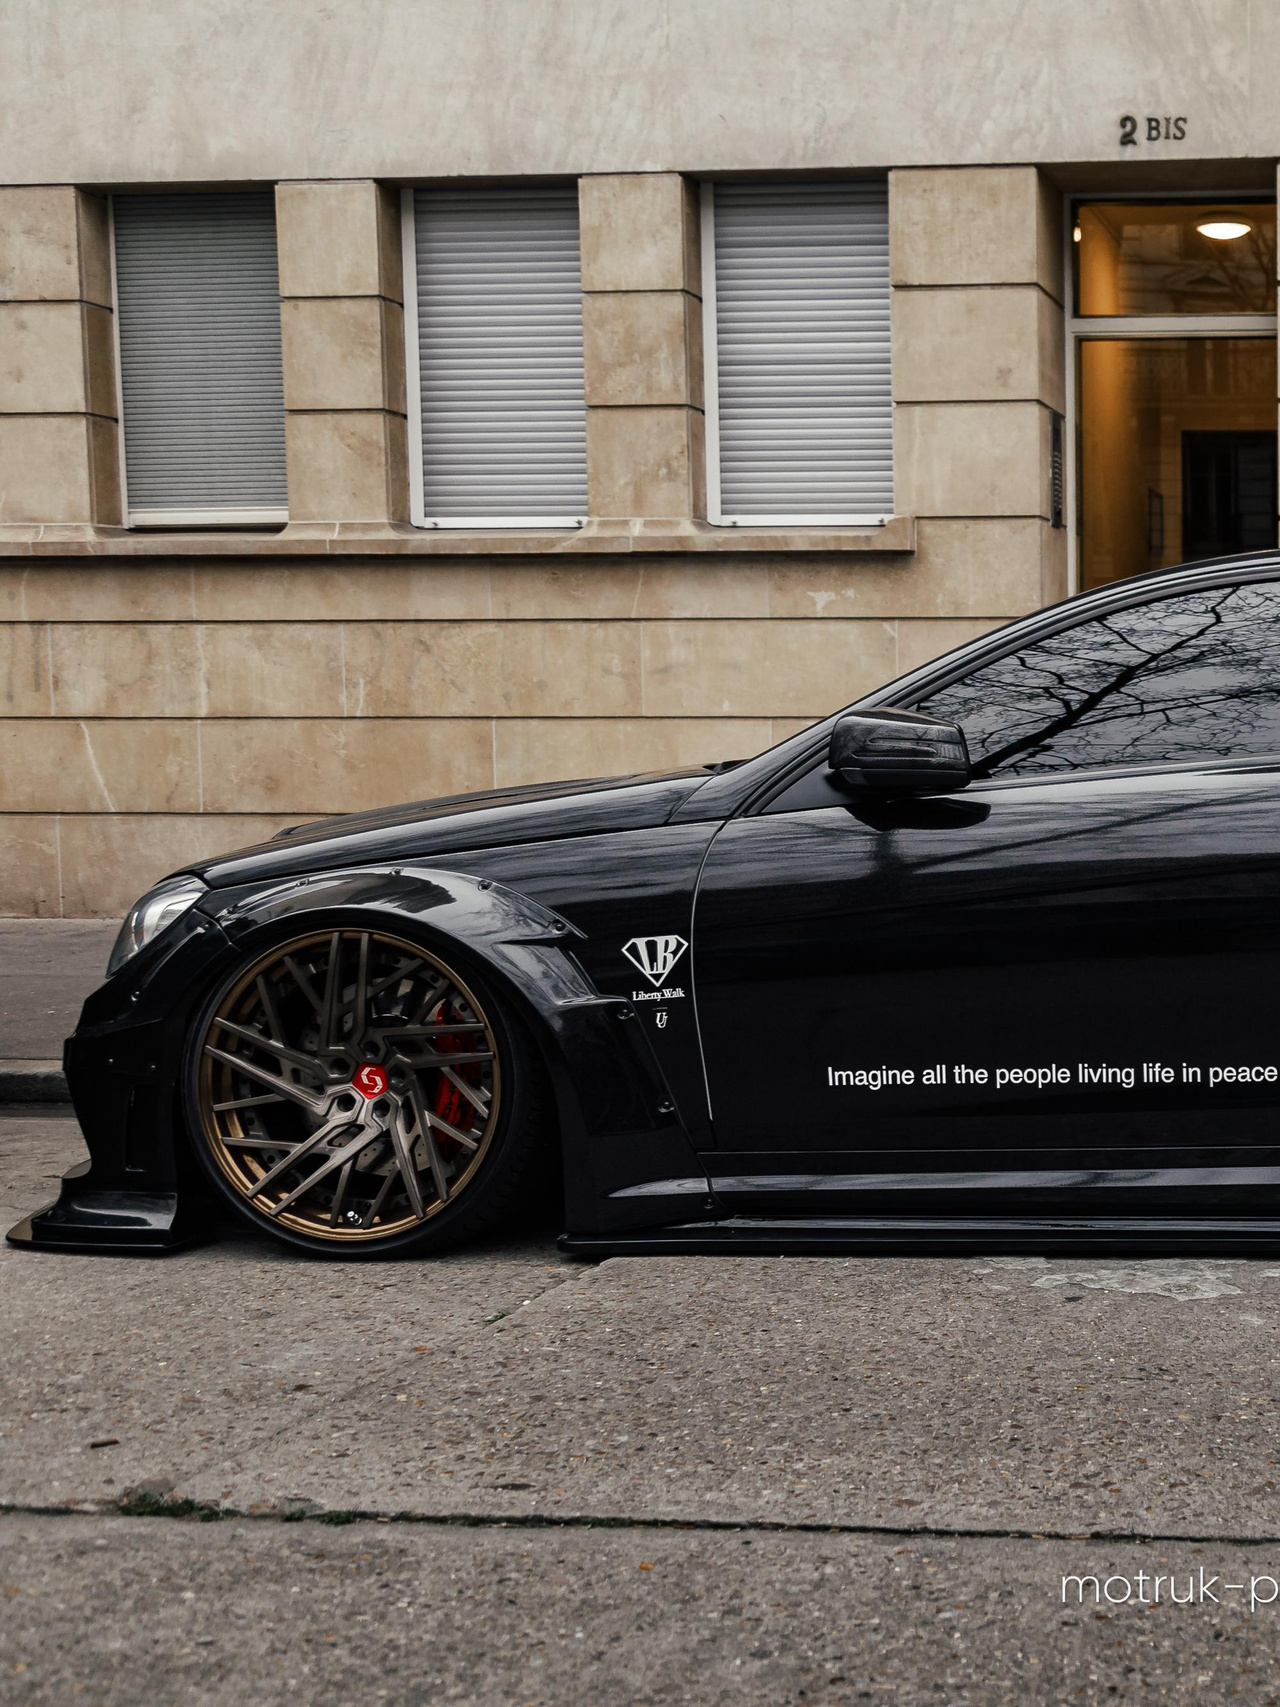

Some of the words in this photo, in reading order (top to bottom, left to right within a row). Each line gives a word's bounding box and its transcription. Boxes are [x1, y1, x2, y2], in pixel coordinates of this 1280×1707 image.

[1119, 115, 1138, 146] 2
[1146, 116, 1188, 141] BIS
[632, 991, 662, 1002] Liberty
[662, 988, 686, 998] Walk
[828, 1066, 914, 1090] Imagine
[922, 1065, 946, 1084] all
[953, 1064, 988, 1084] the
[996, 1064, 1070, 1088] people
[1079, 1064, 1134, 1088] living
[1143, 1063, 1174, 1083] life
[1183, 1063, 1201, 1082] in
[1209, 1066, 1278, 1087] peace
